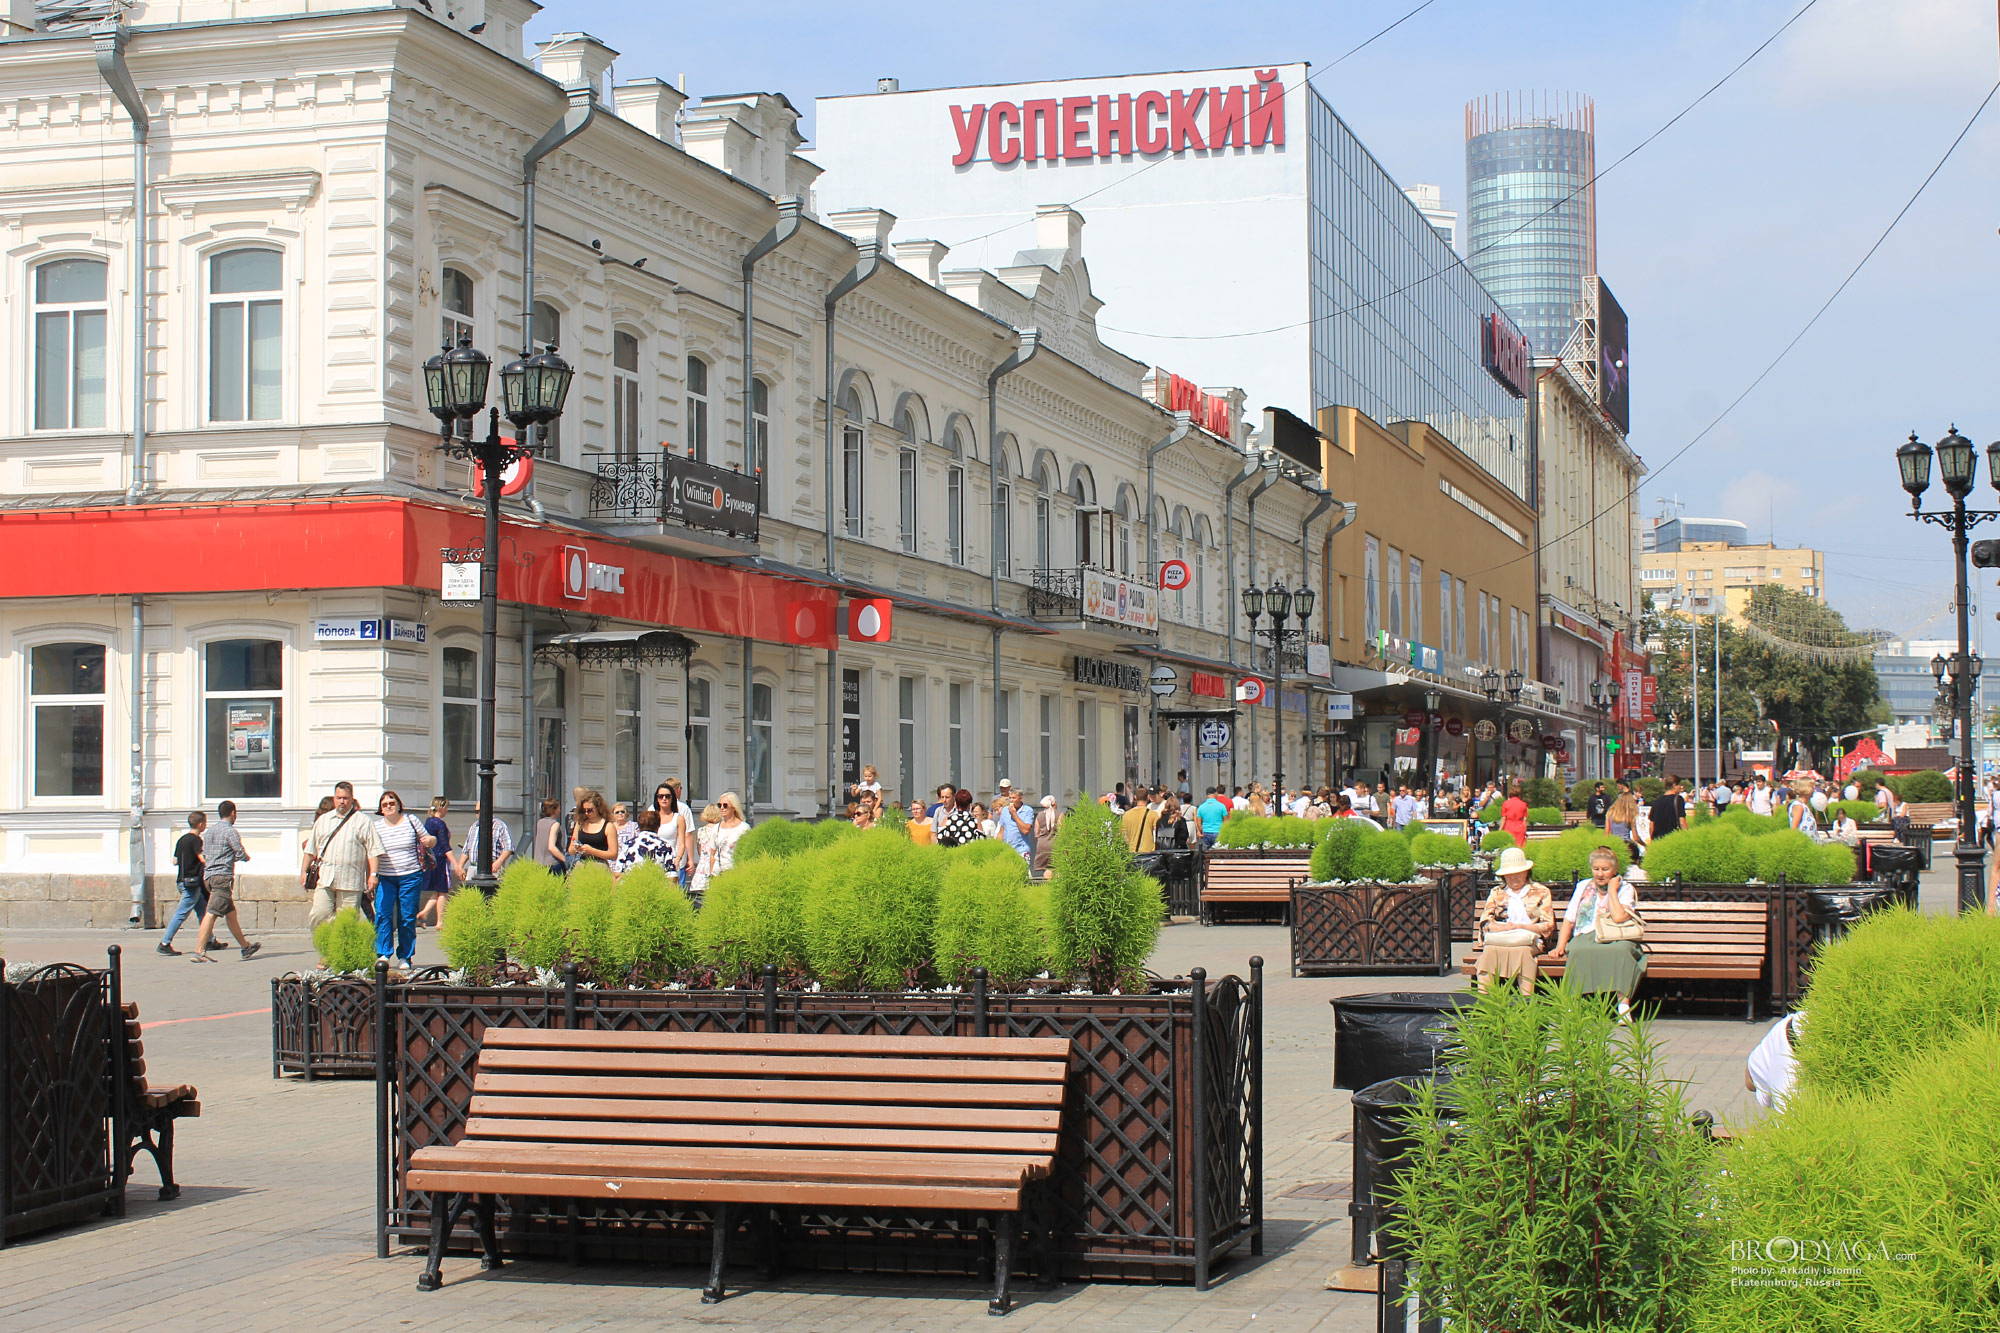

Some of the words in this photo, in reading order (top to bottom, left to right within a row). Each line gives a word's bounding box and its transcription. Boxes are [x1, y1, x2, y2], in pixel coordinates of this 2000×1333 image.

[949, 69, 1286, 166] УСПЕНСКИЙ
[686, 484, 712, 503] Winline
[318, 627, 356, 637] ПОПОВА
[364, 623, 373, 637] 2
[394, 627, 416, 638] ВАЙНЕРА
[417, 627, 425, 640] 12
[1078, 656, 1101, 686] BLACK
[1101, 660, 1118, 689] STAR
[1118, 663, 1142, 692] BURGER
[1631, 676, 1639, 707] ОПТИКА
